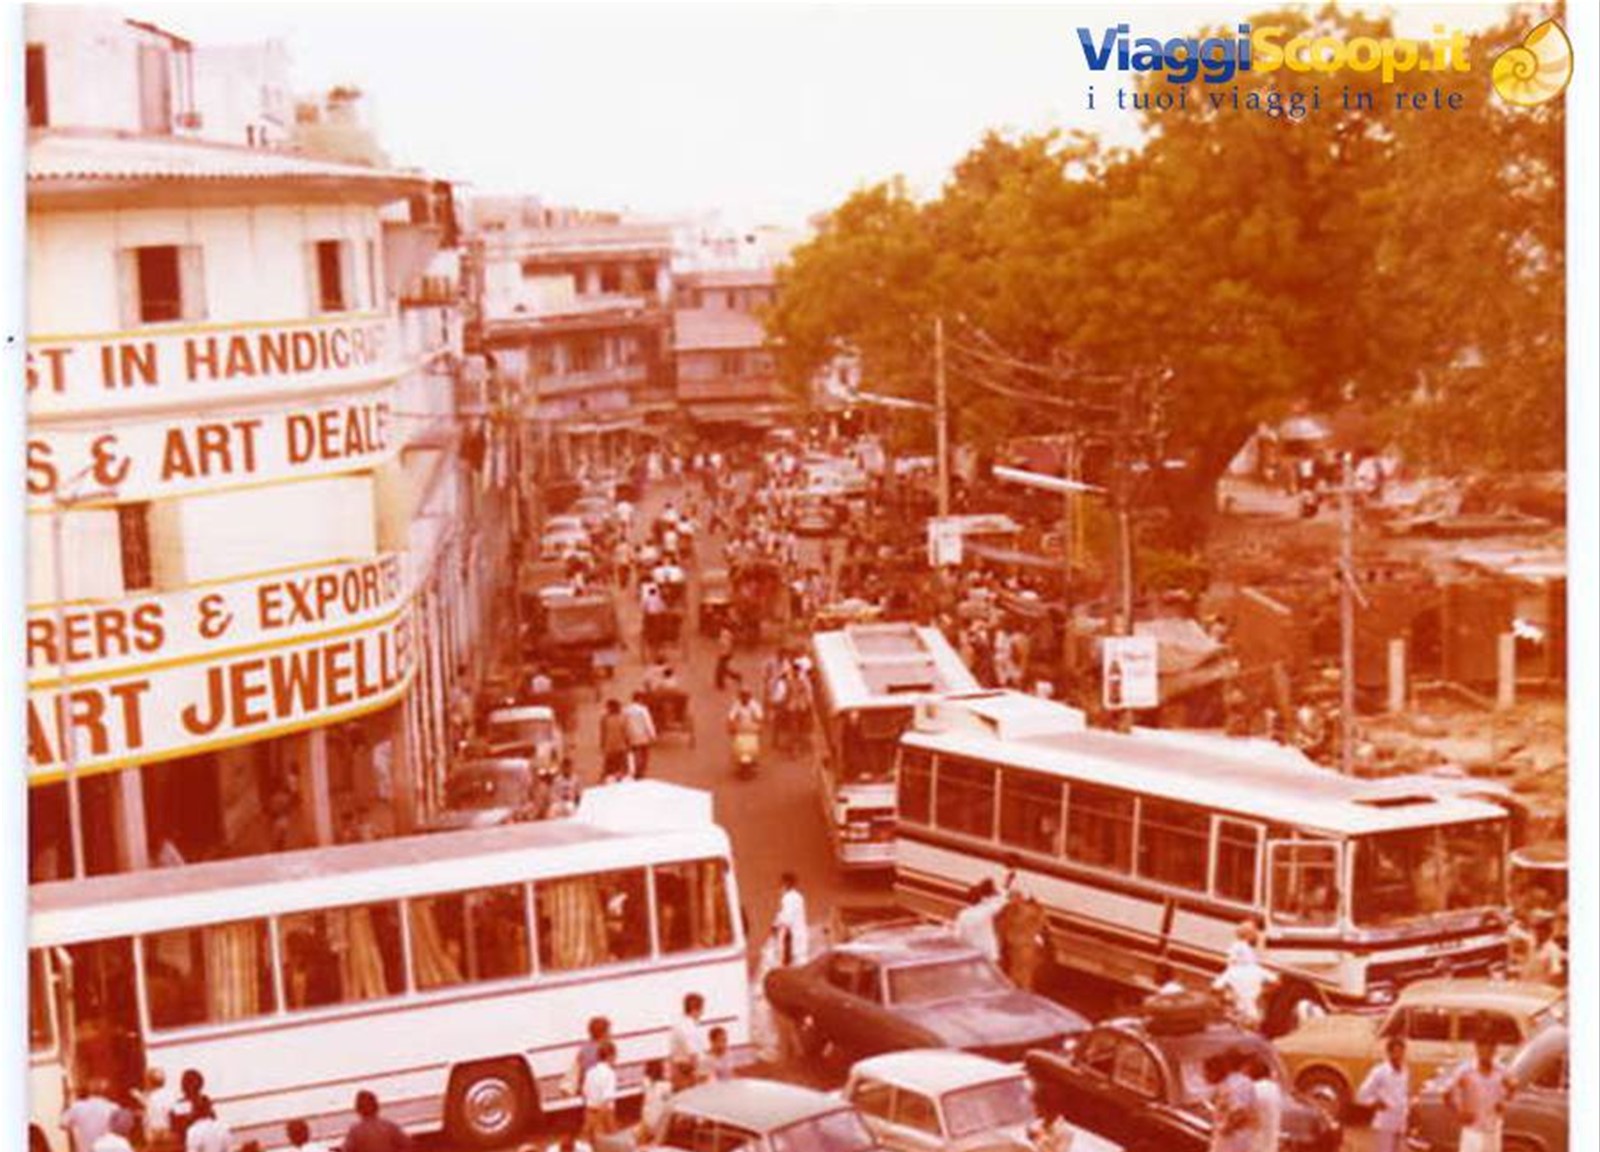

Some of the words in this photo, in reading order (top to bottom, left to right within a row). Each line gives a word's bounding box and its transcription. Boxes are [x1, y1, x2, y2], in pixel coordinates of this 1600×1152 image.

[101, 343, 158, 389] IN
[26, 440, 57, 494] S
[91, 434, 131, 486] &
[161, 420, 262, 482] ART
[27, 603, 164, 668] RERS
[198, 594, 234, 640] &
